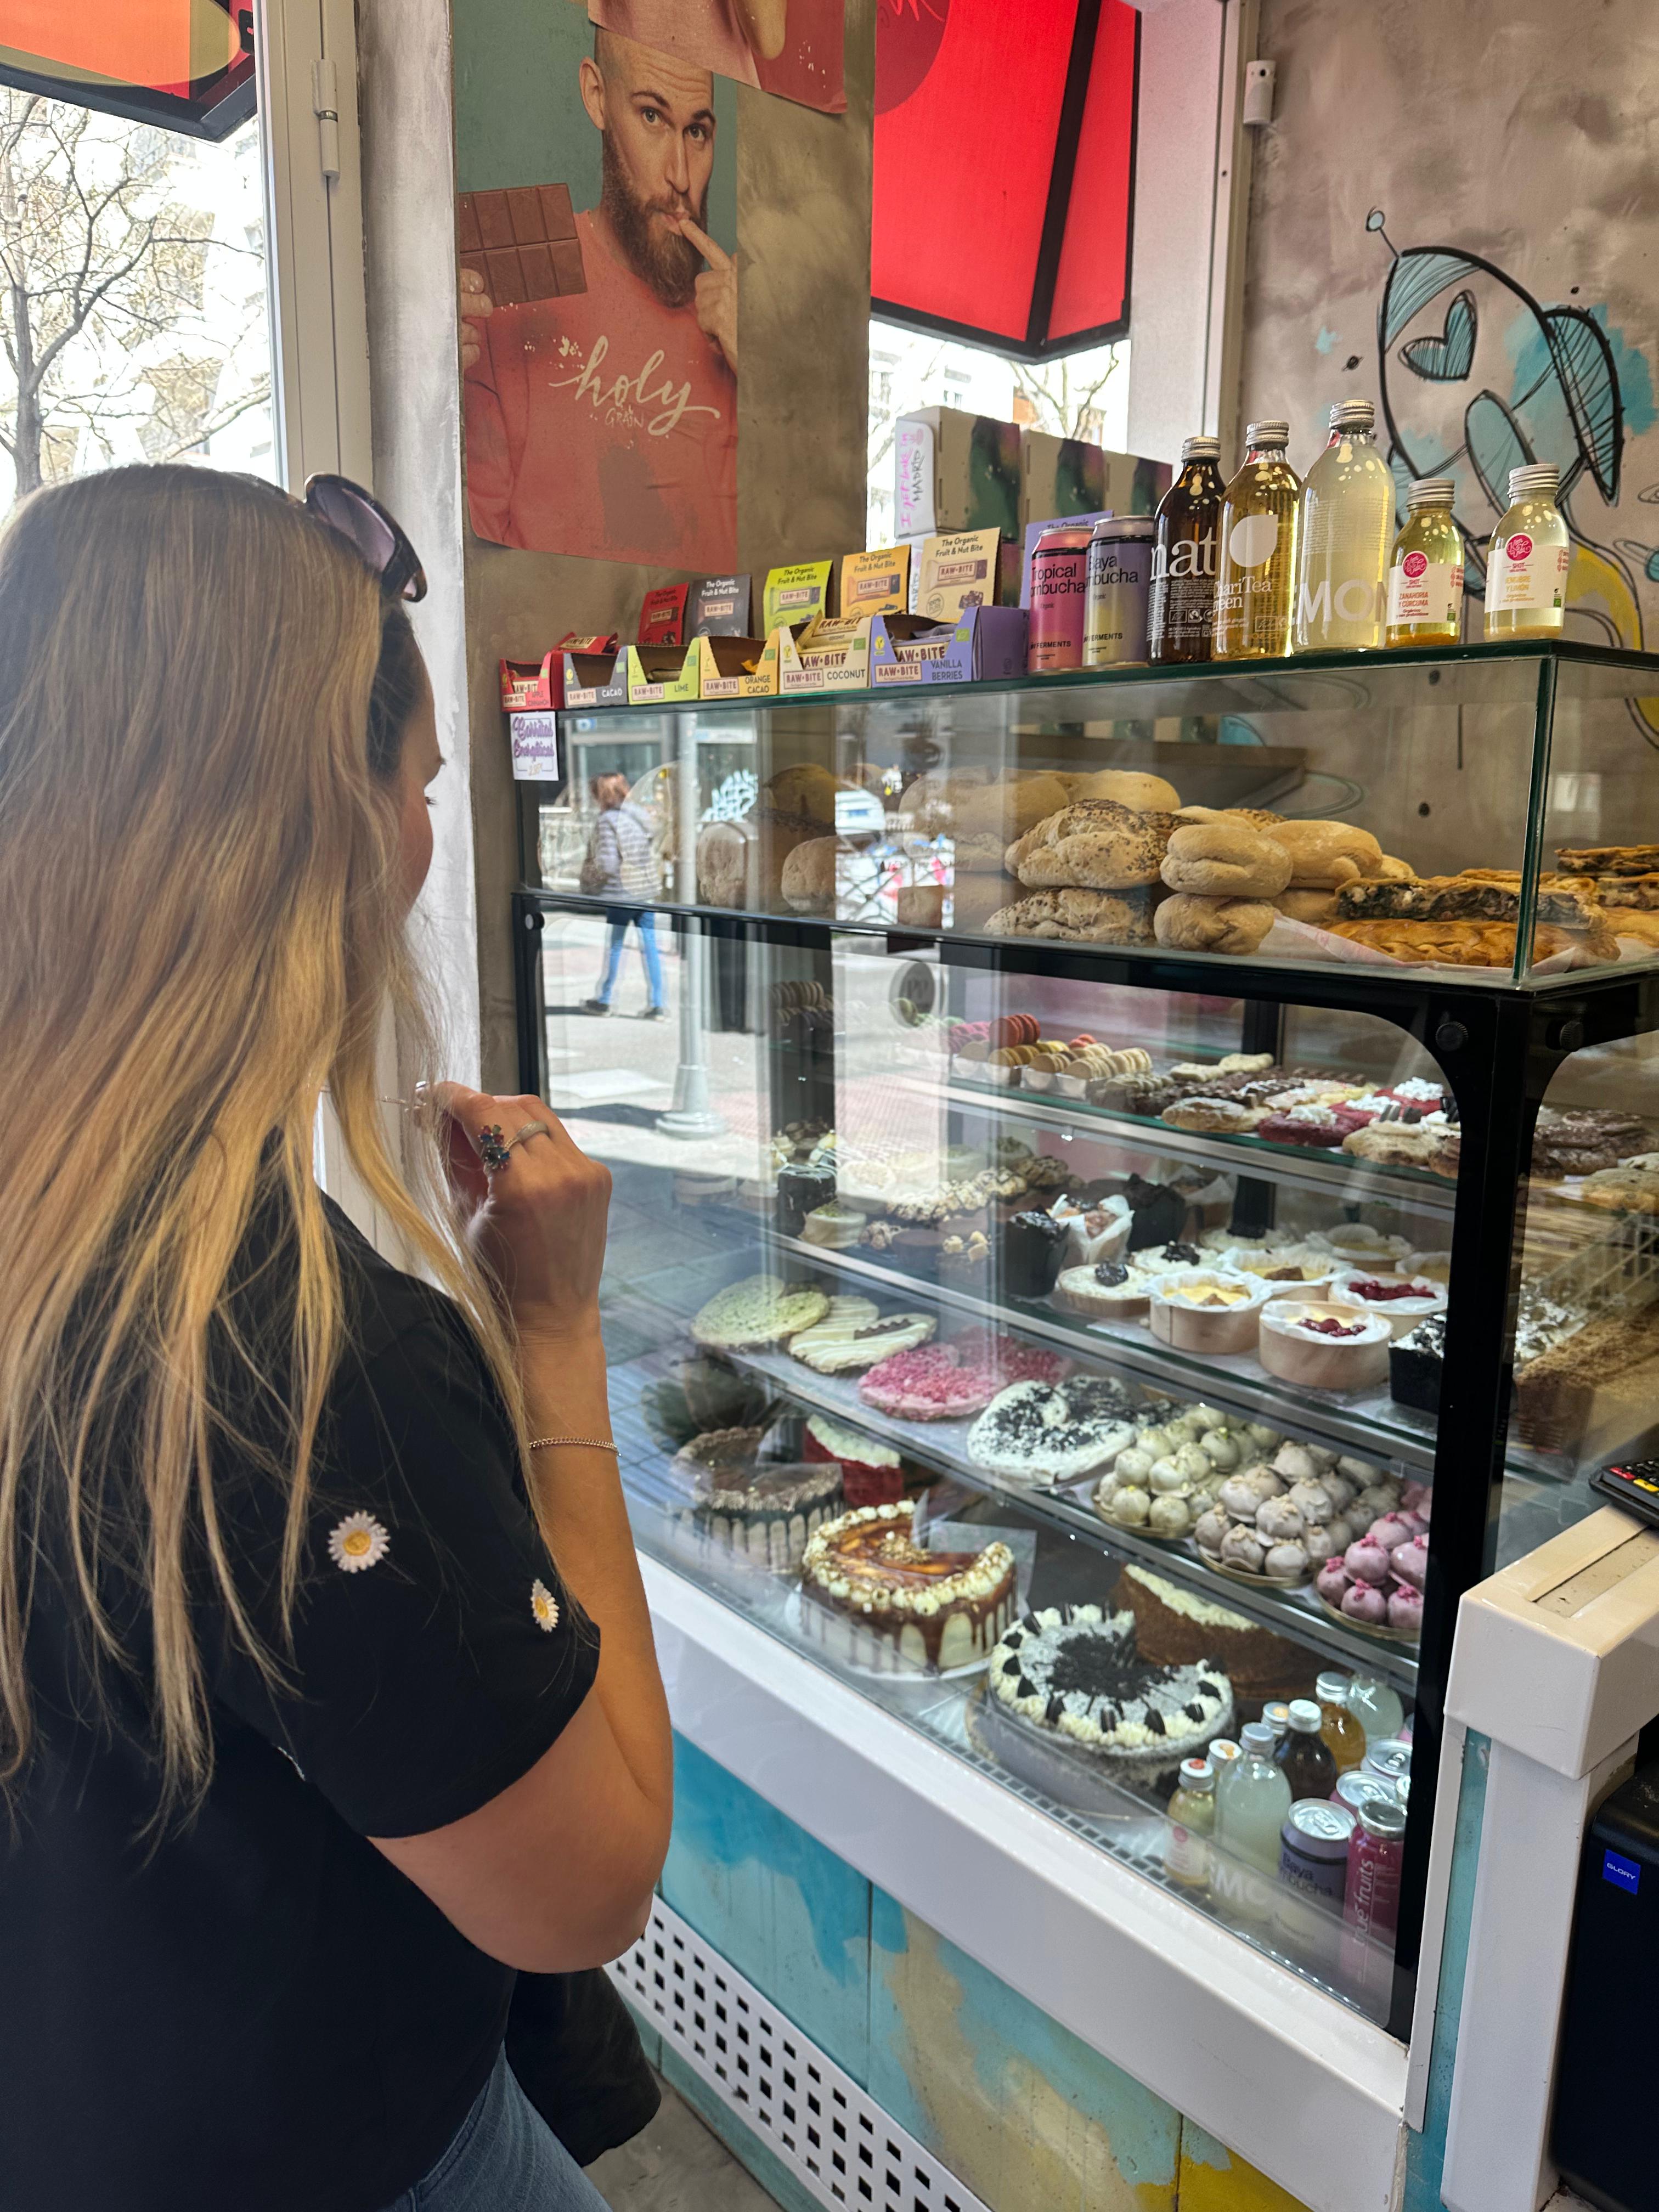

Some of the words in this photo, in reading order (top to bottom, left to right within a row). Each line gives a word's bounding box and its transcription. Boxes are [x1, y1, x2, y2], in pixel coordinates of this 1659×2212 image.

[549, 335, 720, 436] holy
[911, 450, 926, 502] MADRID
[942, 539, 953, 548] The
[954, 534, 979, 546] Organic
[935, 549, 950, 558] Fruit
[957, 546, 970, 555] Nut
[970, 544, 984, 552] Bite
[870, 552, 892, 562] Organic
[884, 560, 896, 568] Bite
[794, 566, 815, 576] Organic
[1031, 562, 1077, 584] Tropical
[715, 579, 736, 588] Organic
[1088, 632, 1123, 641] FERMENTS
[1036, 641, 1071, 649] FERMENTS
[930, 659, 963, 669] VANILLA
[744, 674, 771, 684] ORANGE
[827, 669, 866, 681] COCONUT
[932, 670, 963, 681] BERRIES
[601, 688, 623, 698] CACAO
[674, 684, 690, 692] LIME
[747, 685, 770, 694] CACAO
[1606, 1863, 1636, 1880] GLORY
[1353, 1858, 1374, 1906] fruits
